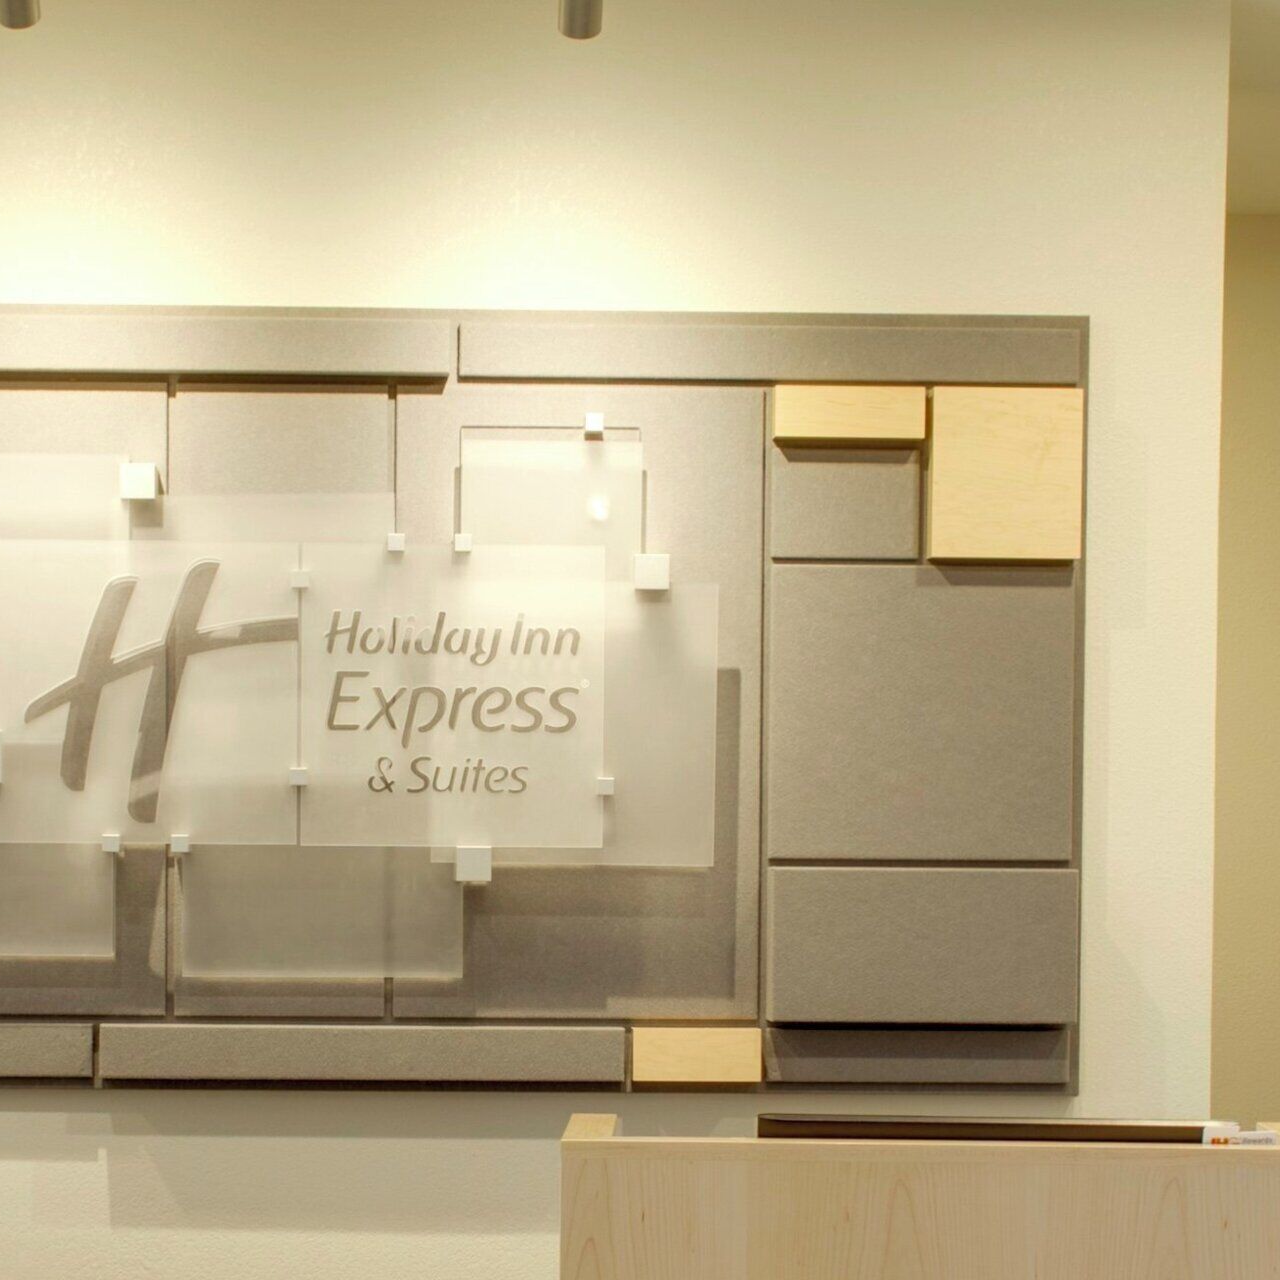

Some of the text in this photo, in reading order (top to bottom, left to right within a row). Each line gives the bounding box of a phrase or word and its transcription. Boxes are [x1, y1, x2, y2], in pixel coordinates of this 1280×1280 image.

[324, 609, 582, 666] Holiday Inn
[367, 755, 529, 794] & Suites
